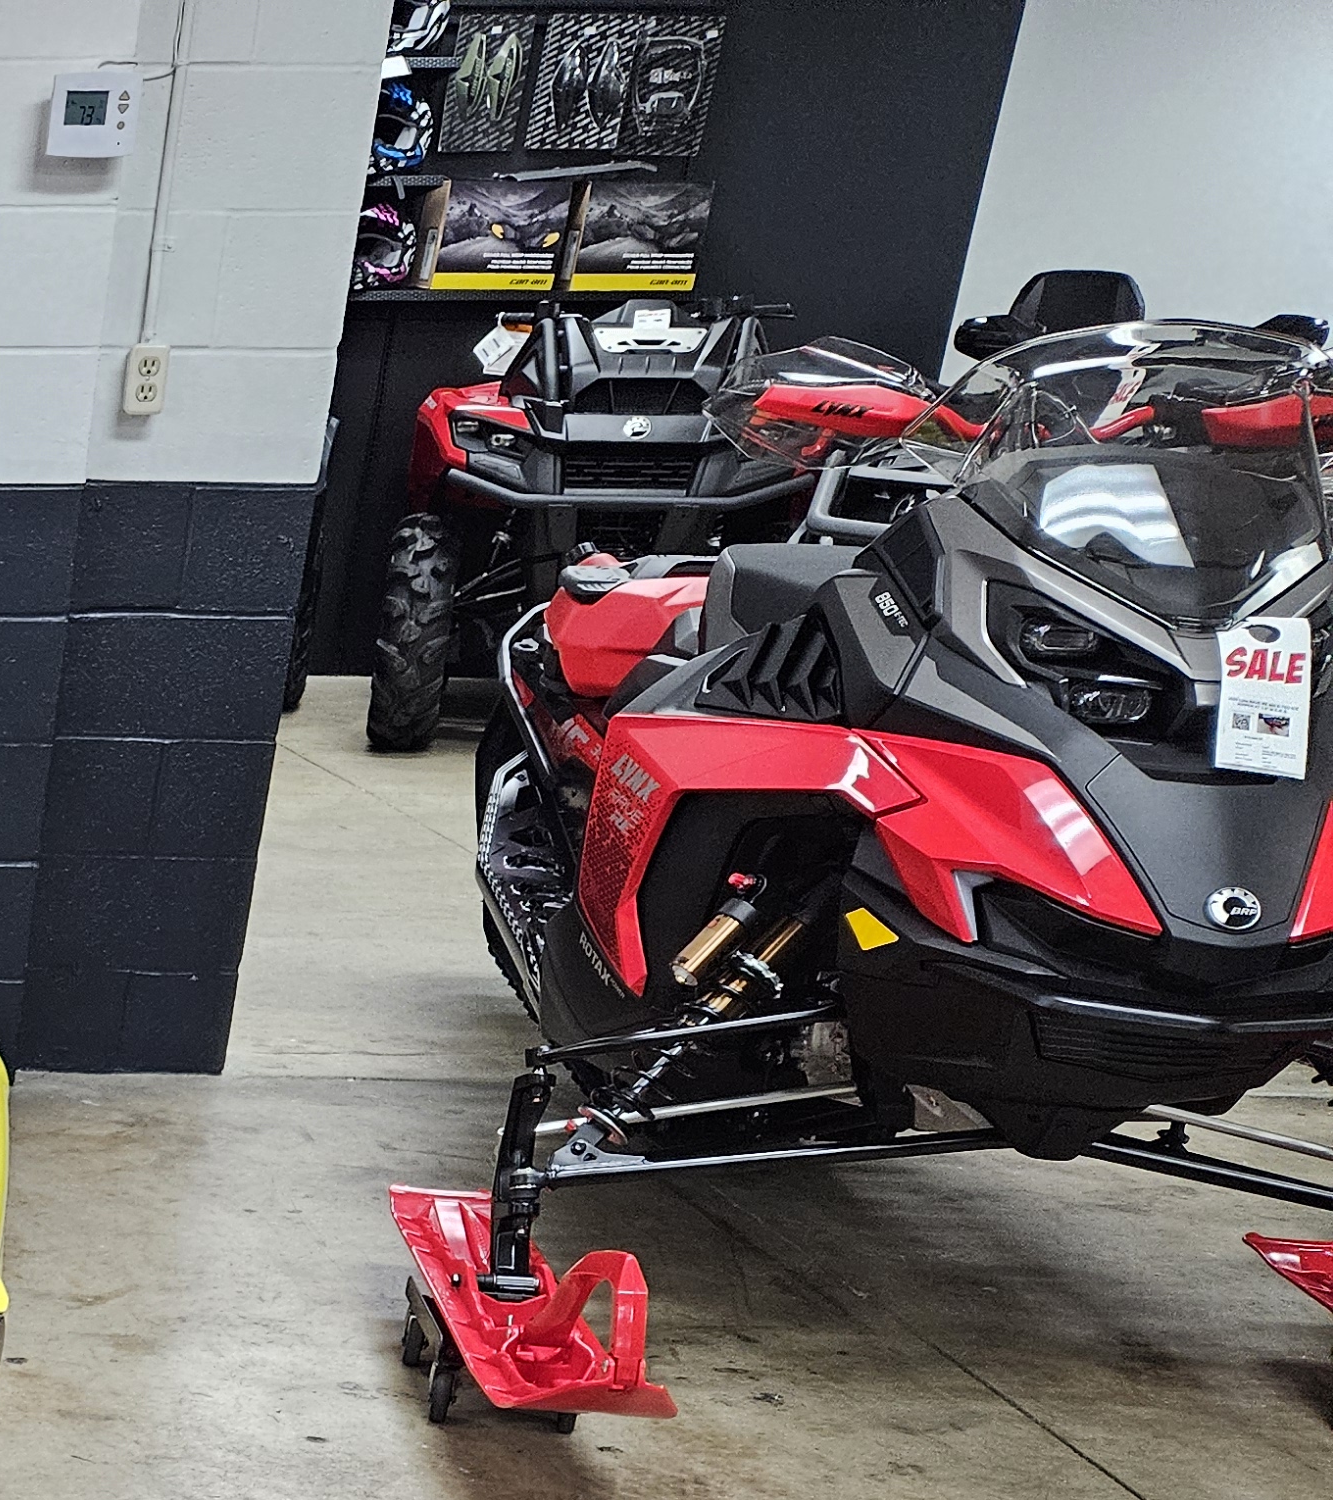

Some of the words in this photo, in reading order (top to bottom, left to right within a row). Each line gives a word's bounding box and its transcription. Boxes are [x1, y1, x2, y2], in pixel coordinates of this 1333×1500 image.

[80, 105, 95, 126] 73
[874, 591, 900, 617] 850
[1225, 646, 1306, 684] SALE
[610, 753, 662, 803] LYNX
[1230, 906, 1258, 916] BRP
[579, 931, 611, 987] ROTAX
